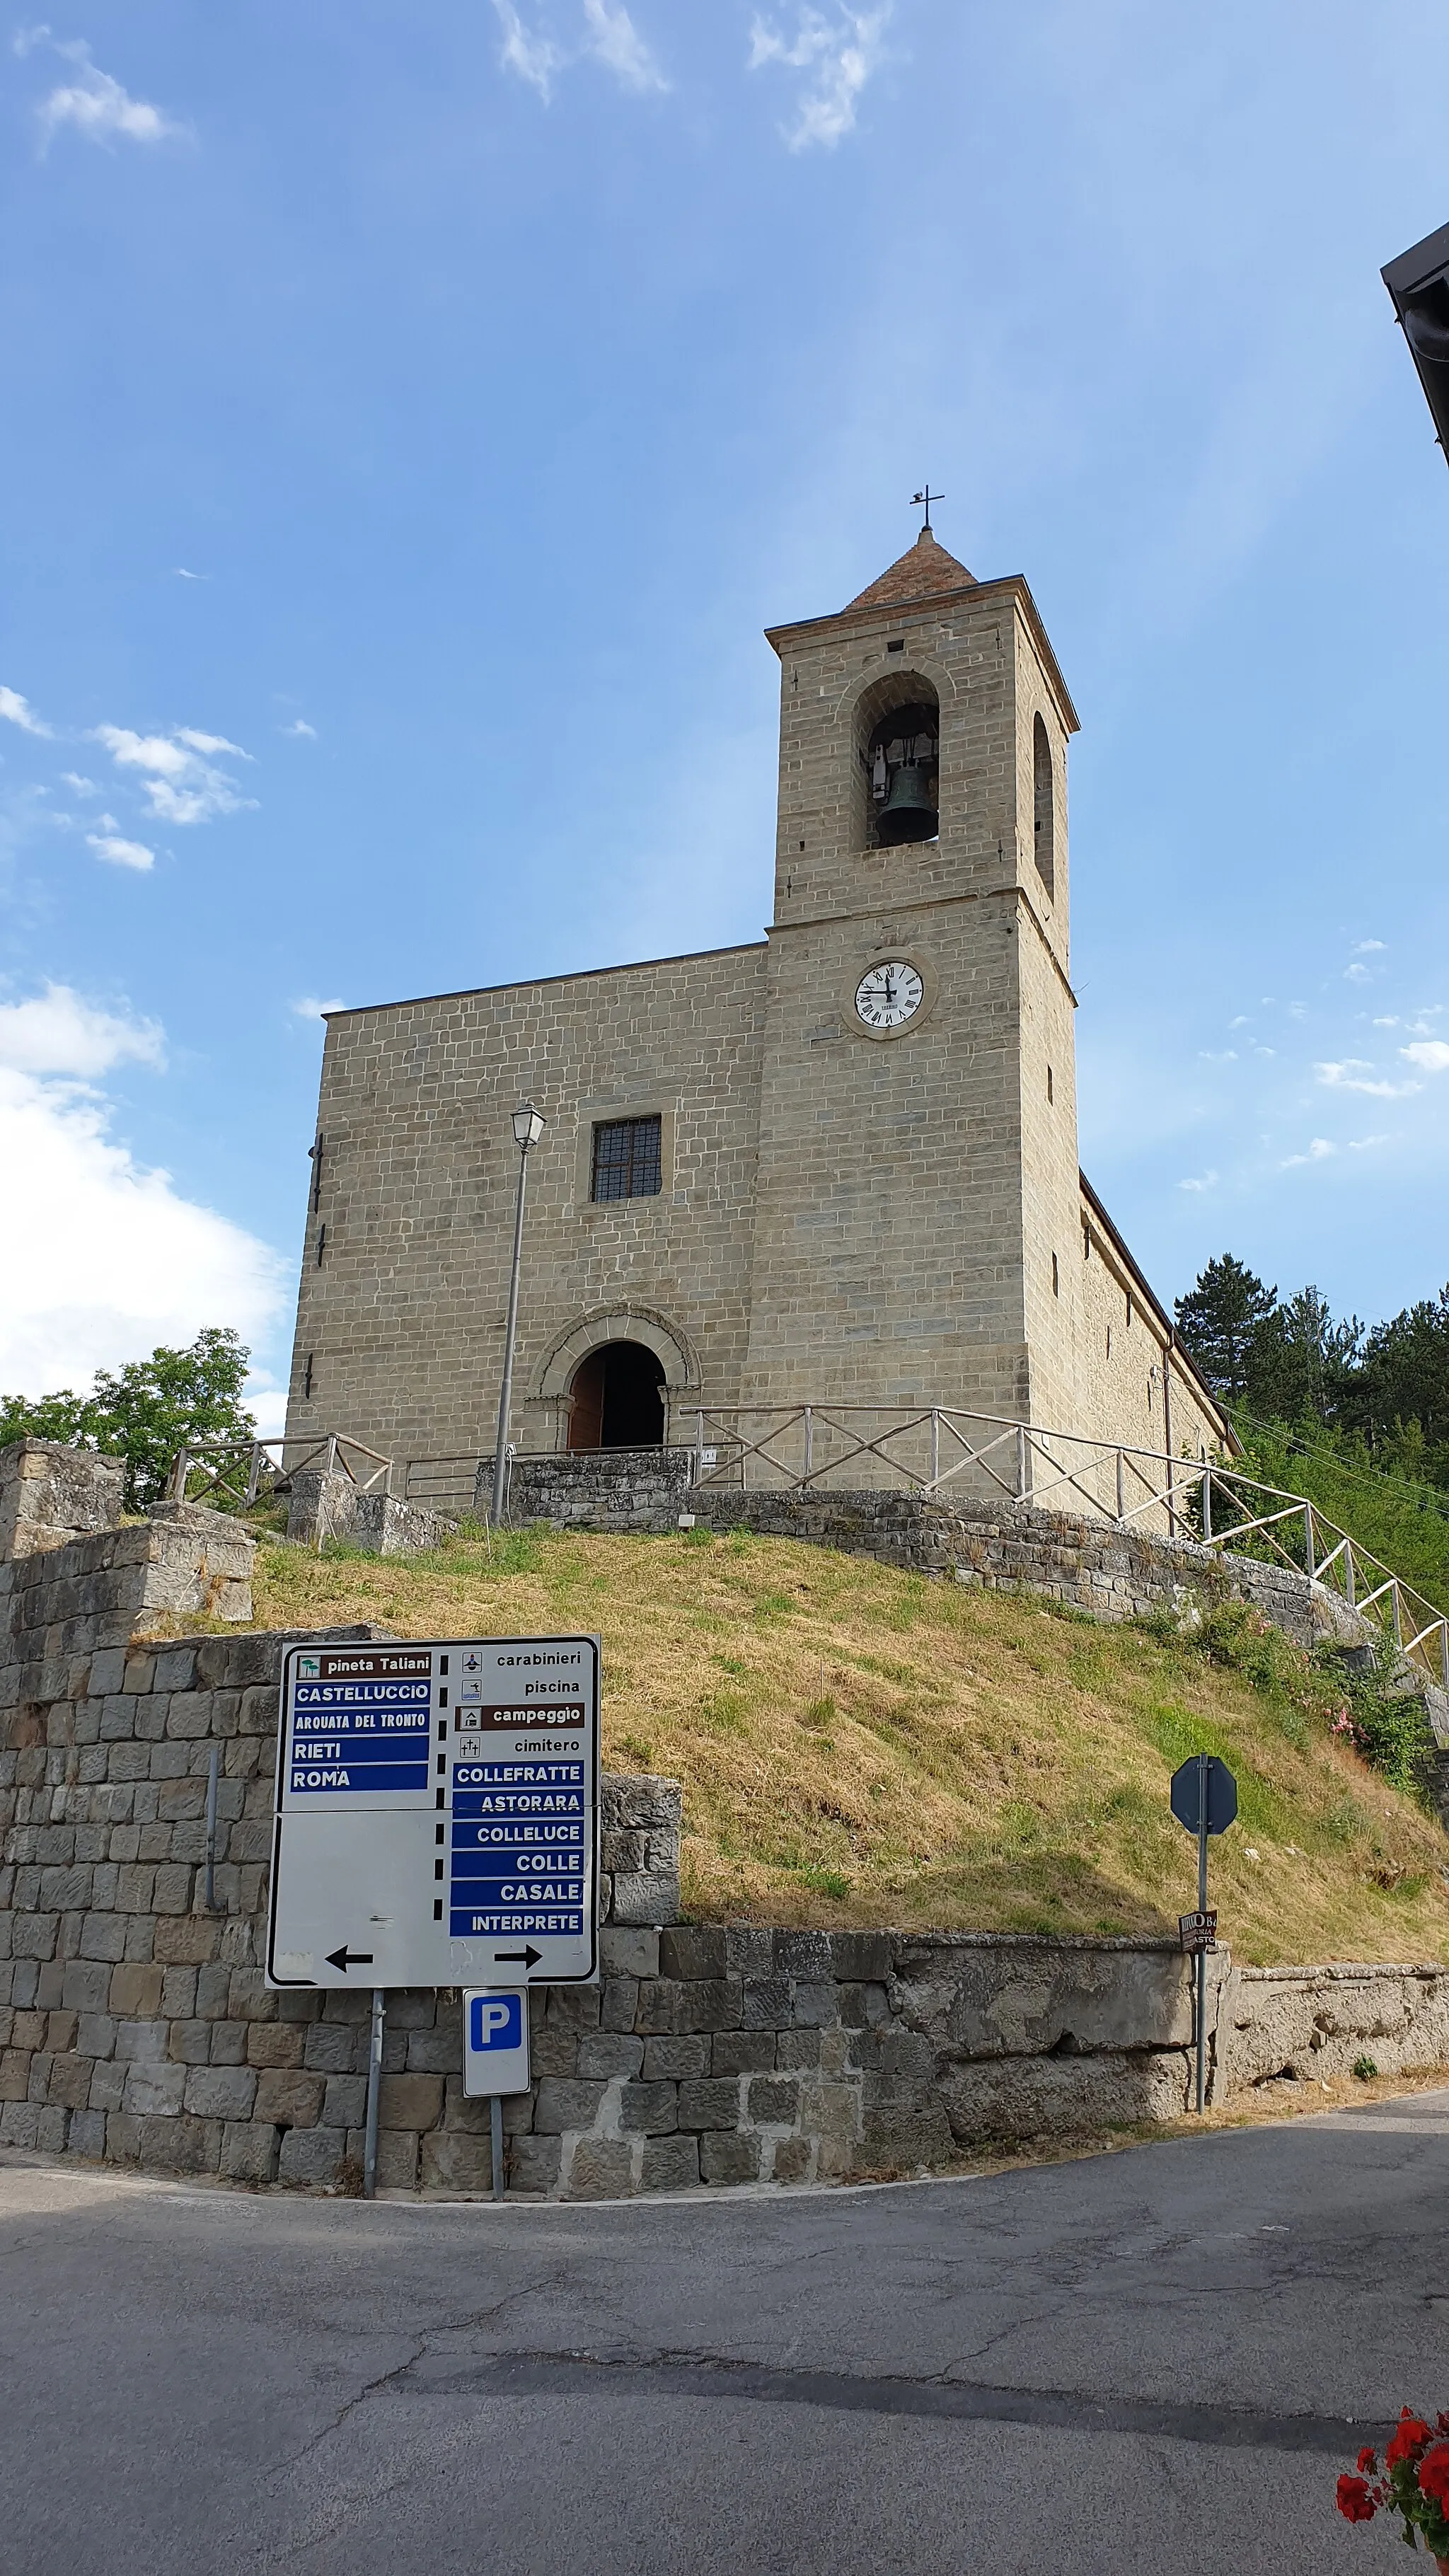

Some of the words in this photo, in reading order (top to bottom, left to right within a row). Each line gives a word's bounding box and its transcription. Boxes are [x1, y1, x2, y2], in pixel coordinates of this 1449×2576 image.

[328, 1659, 374, 1674] pineta
[380, 1656, 429, 1670] Taliani
[497, 1651, 581, 1666] carabinieri
[297, 1685, 428, 1702] CASTELLUCCIO
[525, 1680, 579, 1696] piscina
[296, 1716, 350, 1730] ARQUATA
[355, 1715, 376, 1728] DEL
[381, 1714, 425, 1727] TRONTO
[493, 1706, 580, 1723] campeggio
[294, 1743, 340, 1760] RIETI
[515, 1738, 579, 1752] cimitero
[293, 1770, 350, 1787] ROMA
[457, 1766, 580, 1783] COLLEFRATTE
[481, 1795, 580, 1813] ASTORARA
[478, 1826, 579, 1843] COLLELUCE
[516, 1855, 579, 1871] COLLE
[501, 1884, 579, 1901] CASALE
[472, 1914, 579, 1931] INTERPRETE
[482, 2003, 510, 2044] P
